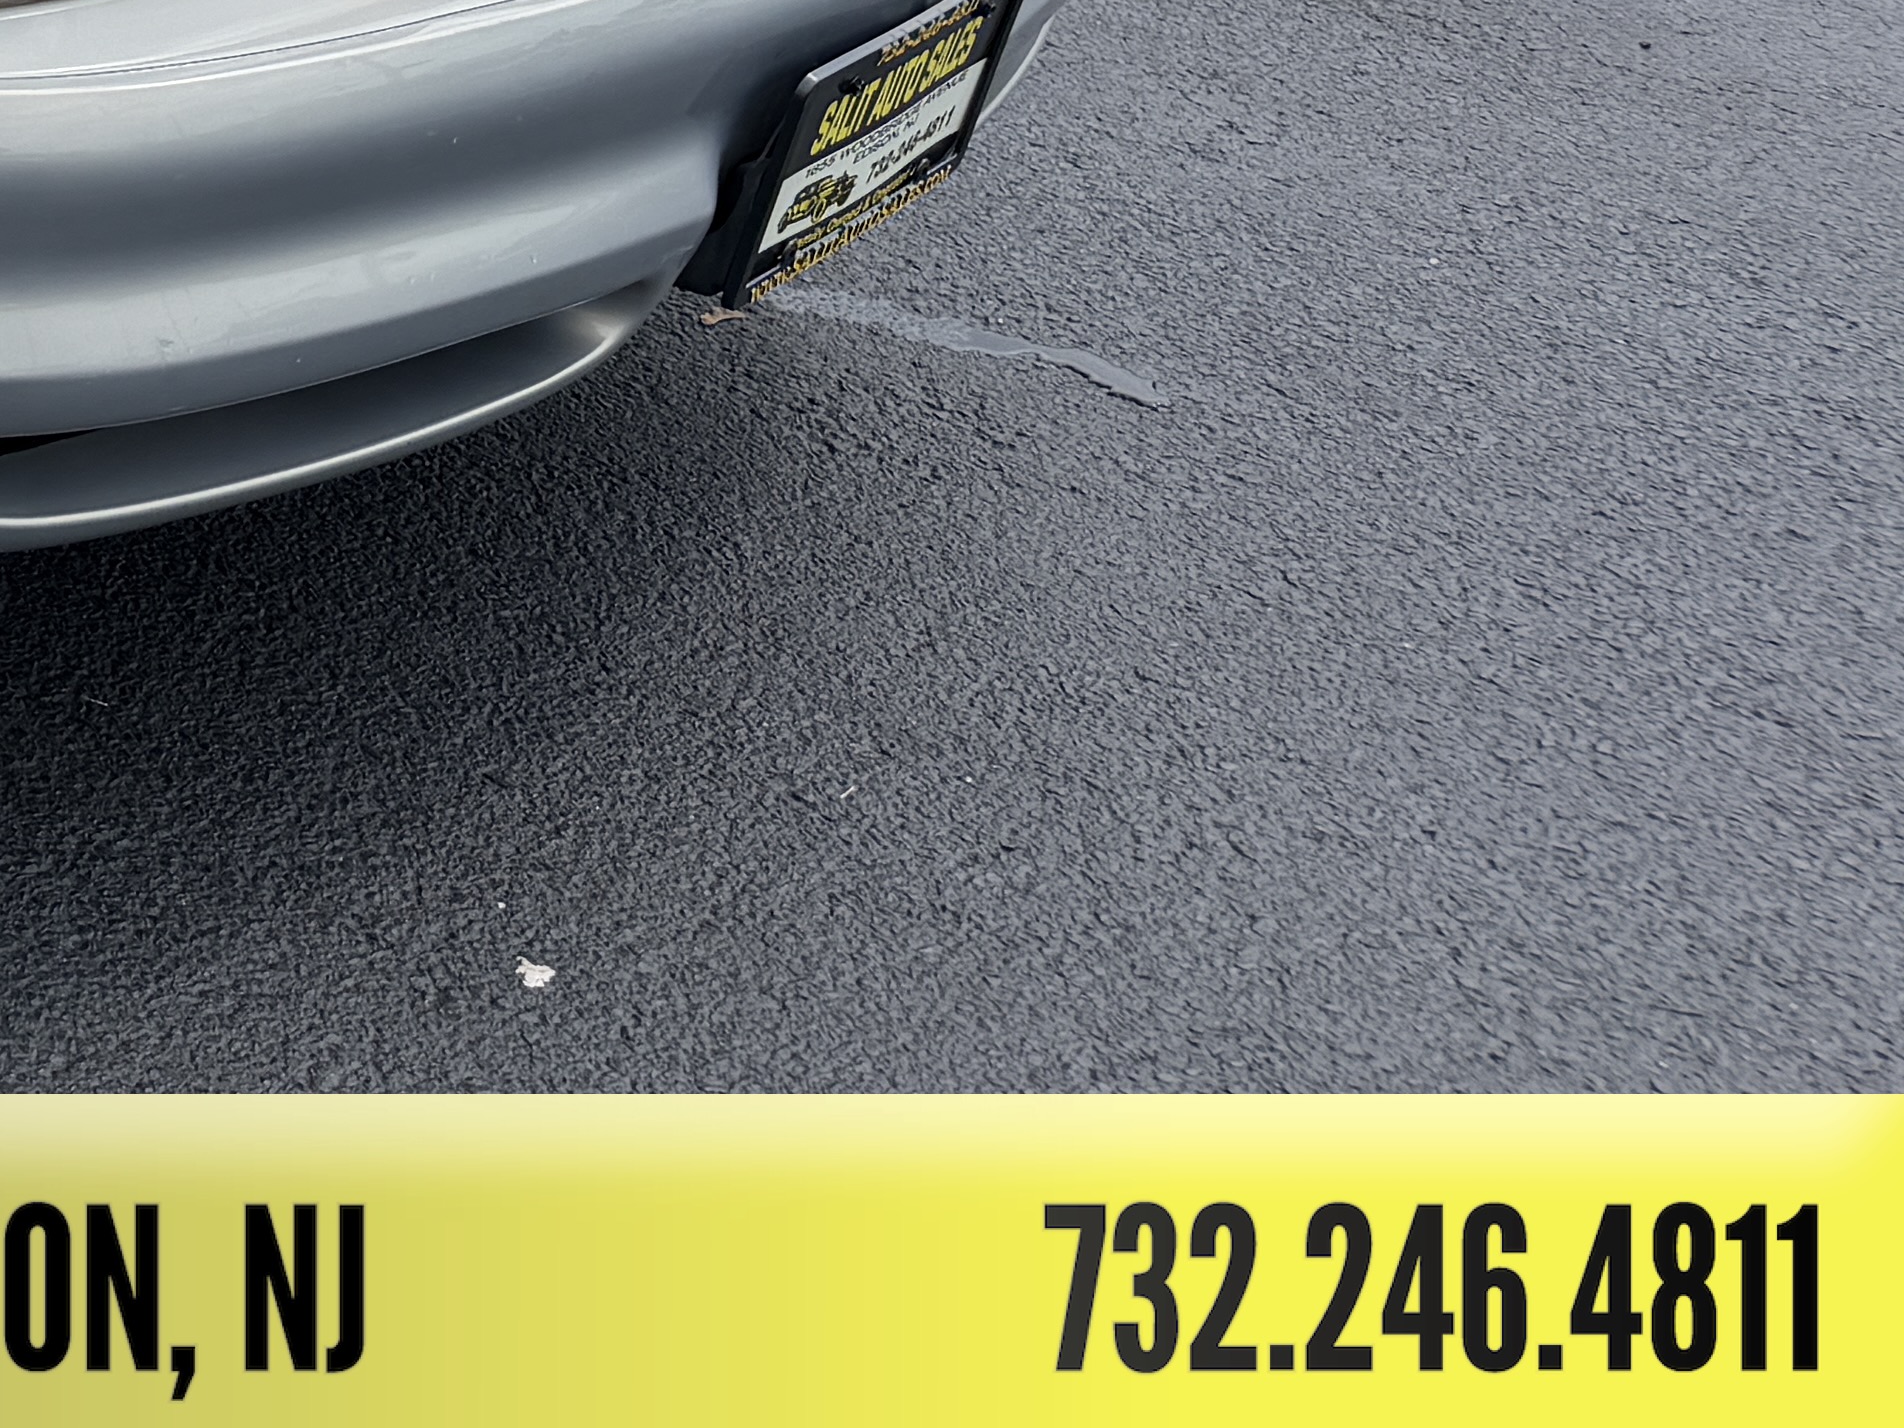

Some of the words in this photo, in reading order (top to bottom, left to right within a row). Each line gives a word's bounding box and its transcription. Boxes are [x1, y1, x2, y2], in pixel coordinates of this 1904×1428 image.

[810, 77, 882, 156] SALIT
[866, 48, 930, 126] AUTO
[918, 15, 984, 93] SALES
